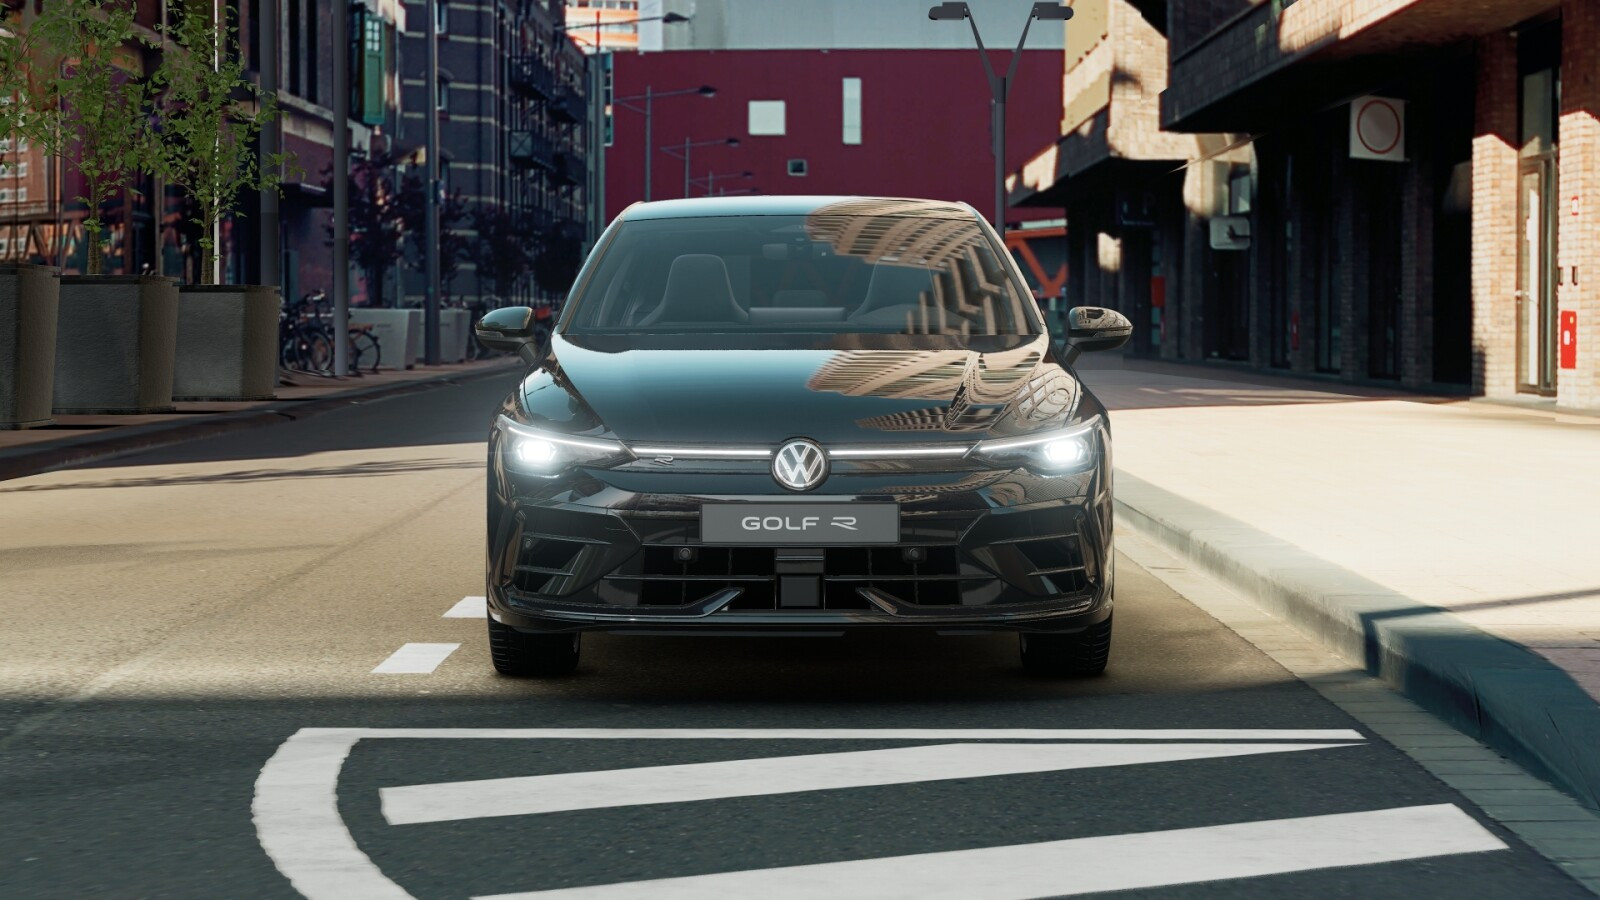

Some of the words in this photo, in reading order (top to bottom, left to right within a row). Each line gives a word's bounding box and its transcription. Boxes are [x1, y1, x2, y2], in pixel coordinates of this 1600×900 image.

[776, 442, 823, 485] VW
[741, 516, 820, 531] GOLF
[830, 516, 859, 531] R
